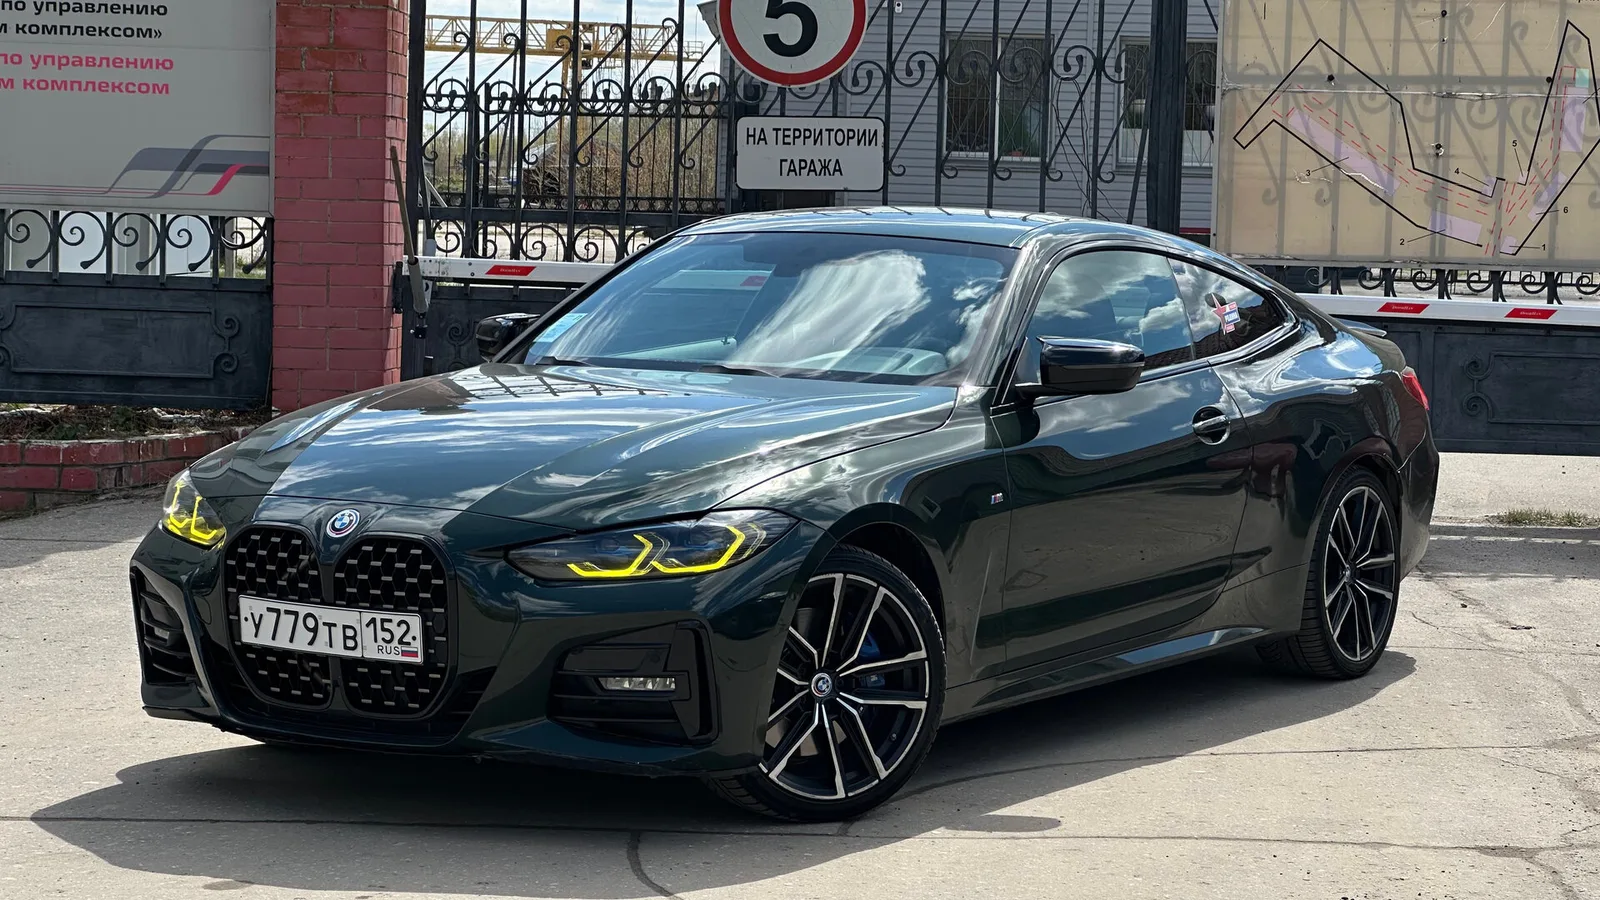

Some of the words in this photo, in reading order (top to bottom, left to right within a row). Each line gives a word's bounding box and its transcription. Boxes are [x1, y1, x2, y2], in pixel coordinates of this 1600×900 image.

[1, 0, 26, 11] по
[33, 0, 168, 16] управлению
[15, 23, 162, 39] комплексом»
[763, 0, 819, 58] 5
[30, 54, 174, 71] управлению
[23, 79, 169, 95] комплексом
[746, 127, 768, 146] НА
[773, 127, 878, 147] ТЕРРИТОРИИ
[779, 158, 843, 177] ГАРАЖА
[1305, 169, 1311, 177] 3
[1563, 206, 1569, 214] 6
[1399, 238, 1405, 246] 2
[1541, 243, 1546, 251] 1
[365, 617, 411, 646] 152
[377, 645, 400, 655] RUS
